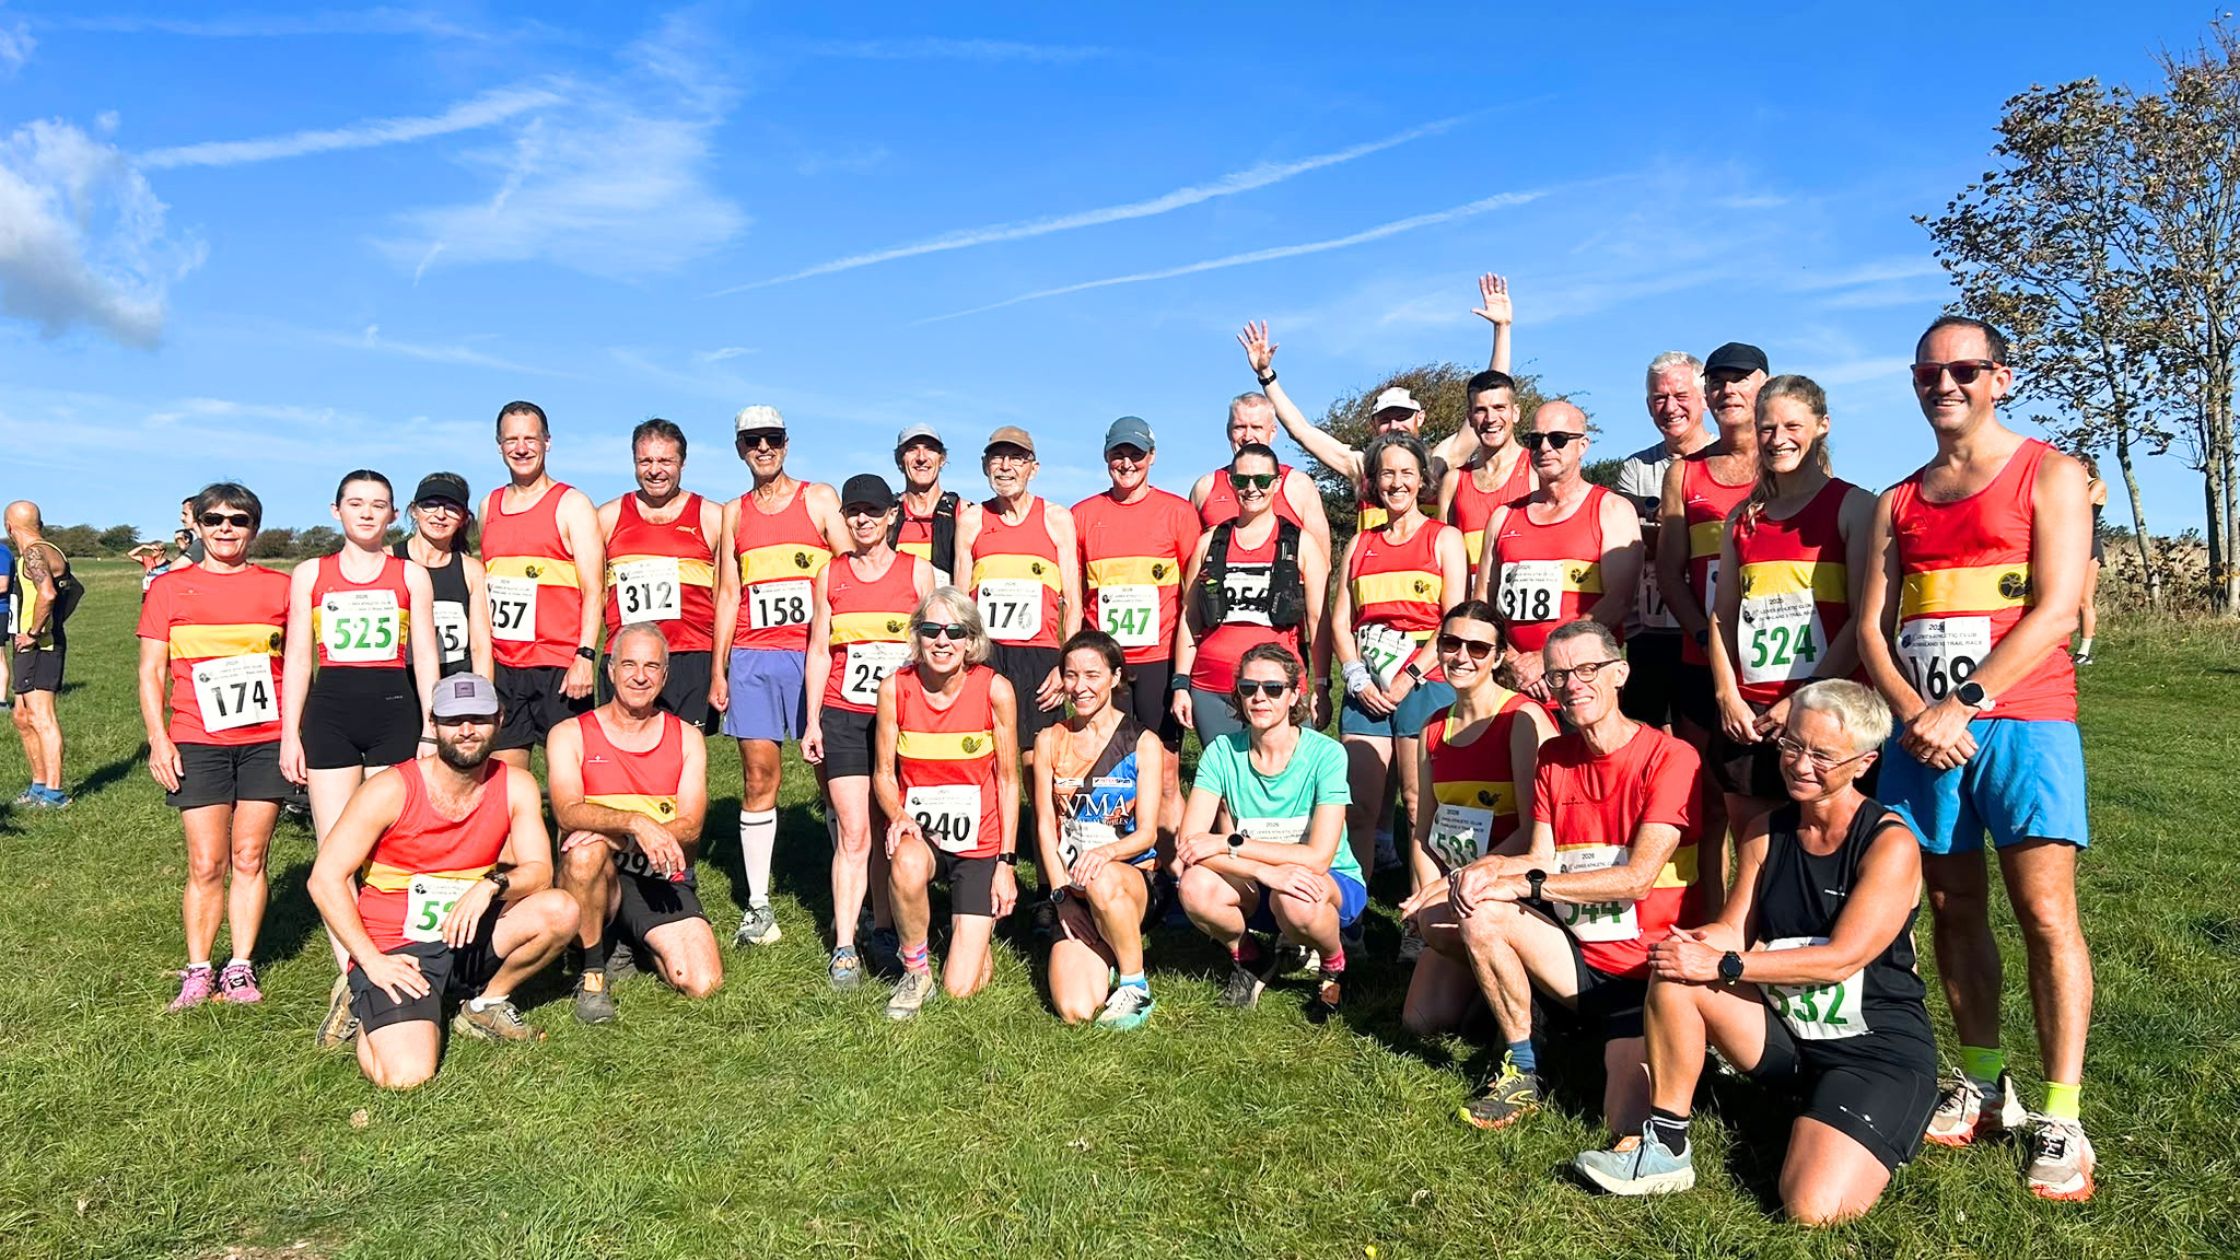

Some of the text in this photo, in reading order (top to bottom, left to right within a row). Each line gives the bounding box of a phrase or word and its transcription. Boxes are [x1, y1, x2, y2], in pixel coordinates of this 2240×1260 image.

[626, 581, 672, 613] 312
[759, 596, 805, 627] 158
[1504, 588, 1550, 620] 318
[490, 598, 528, 629] 257
[988, 602, 1033, 629] 176
[1107, 608, 1151, 636] 547
[334, 617, 392, 649] 525
[1751, 624, 1817, 668] 524
[211, 680, 268, 717] 174
[915, 811, 970, 841] 240
[1768, 981, 1848, 1024] 532
